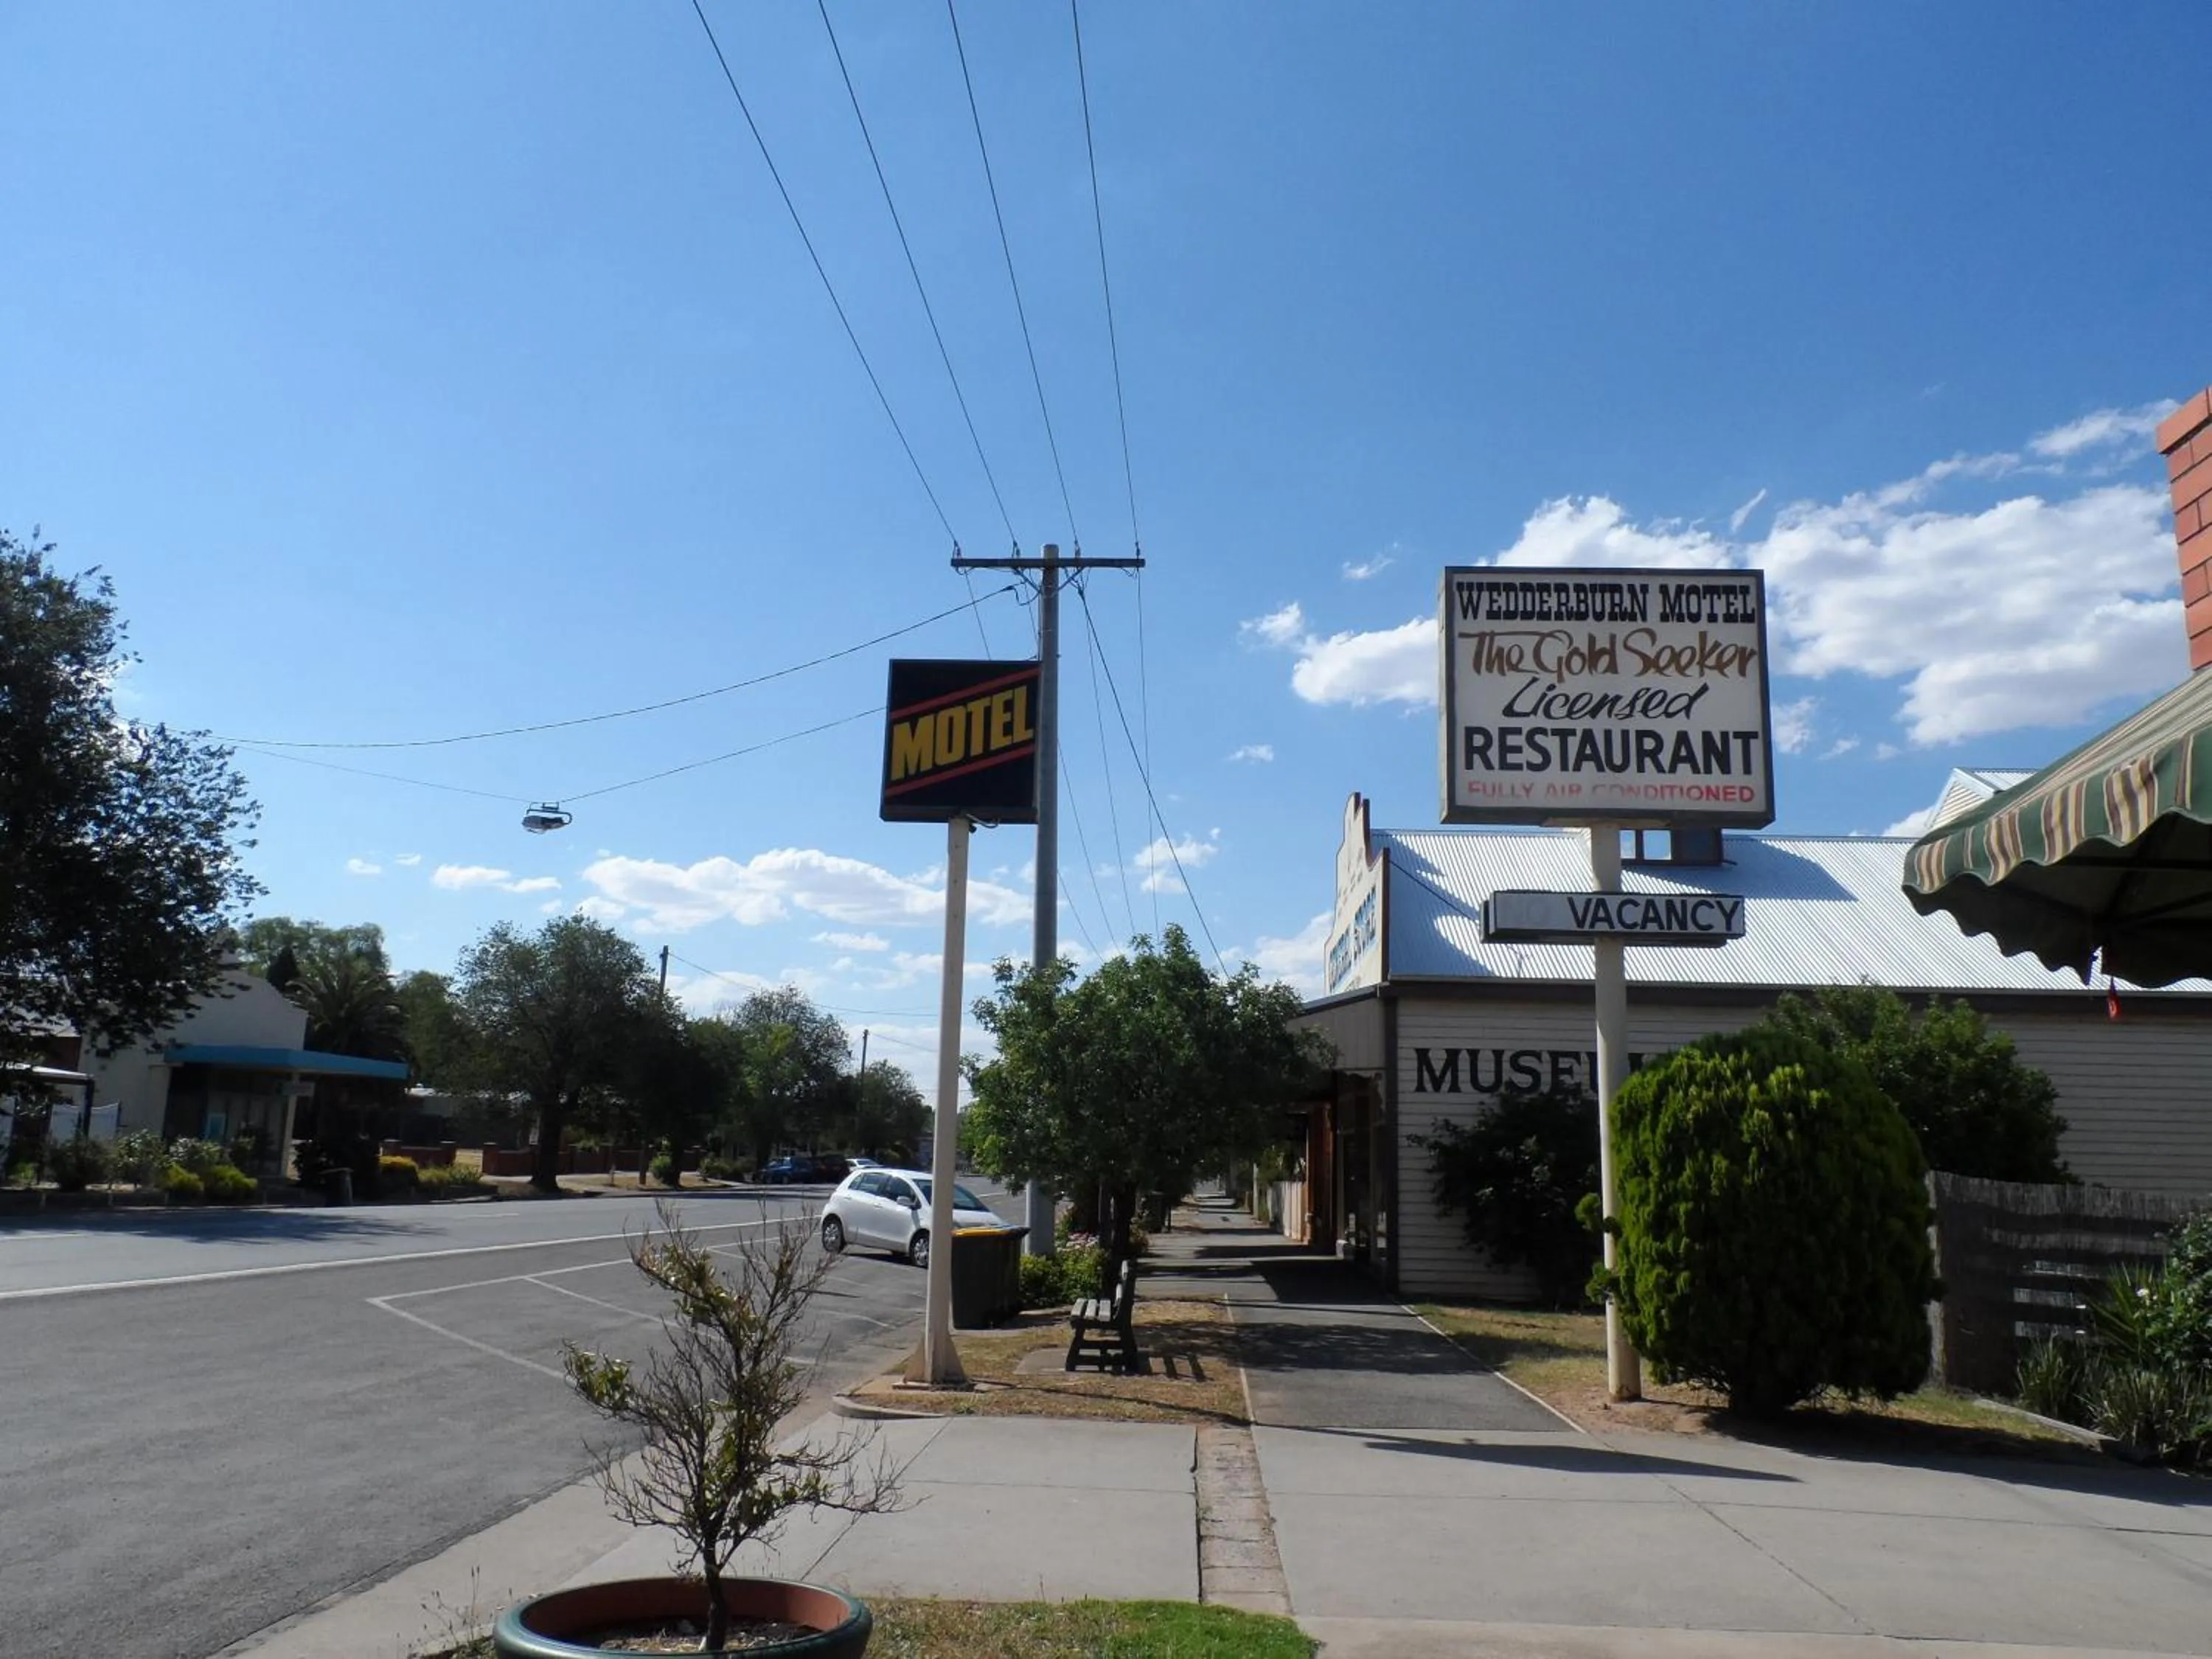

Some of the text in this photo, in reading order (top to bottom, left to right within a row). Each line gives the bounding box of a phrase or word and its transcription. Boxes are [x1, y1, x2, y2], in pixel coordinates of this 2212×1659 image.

[1456, 582, 1756, 625] WEDDERBURN MOTEL
[1458, 627, 1758, 683] The Gold Seeker
[1502, 677, 1710, 720] Licensed
[891, 686, 1034, 781] MOTEL
[1464, 726, 1759, 776] RESTAURANT
[1467, 780, 1535, 799] FULLY
[1568, 896, 1742, 932] VACANCY
[1414, 1048, 1644, 1094] MUSE
